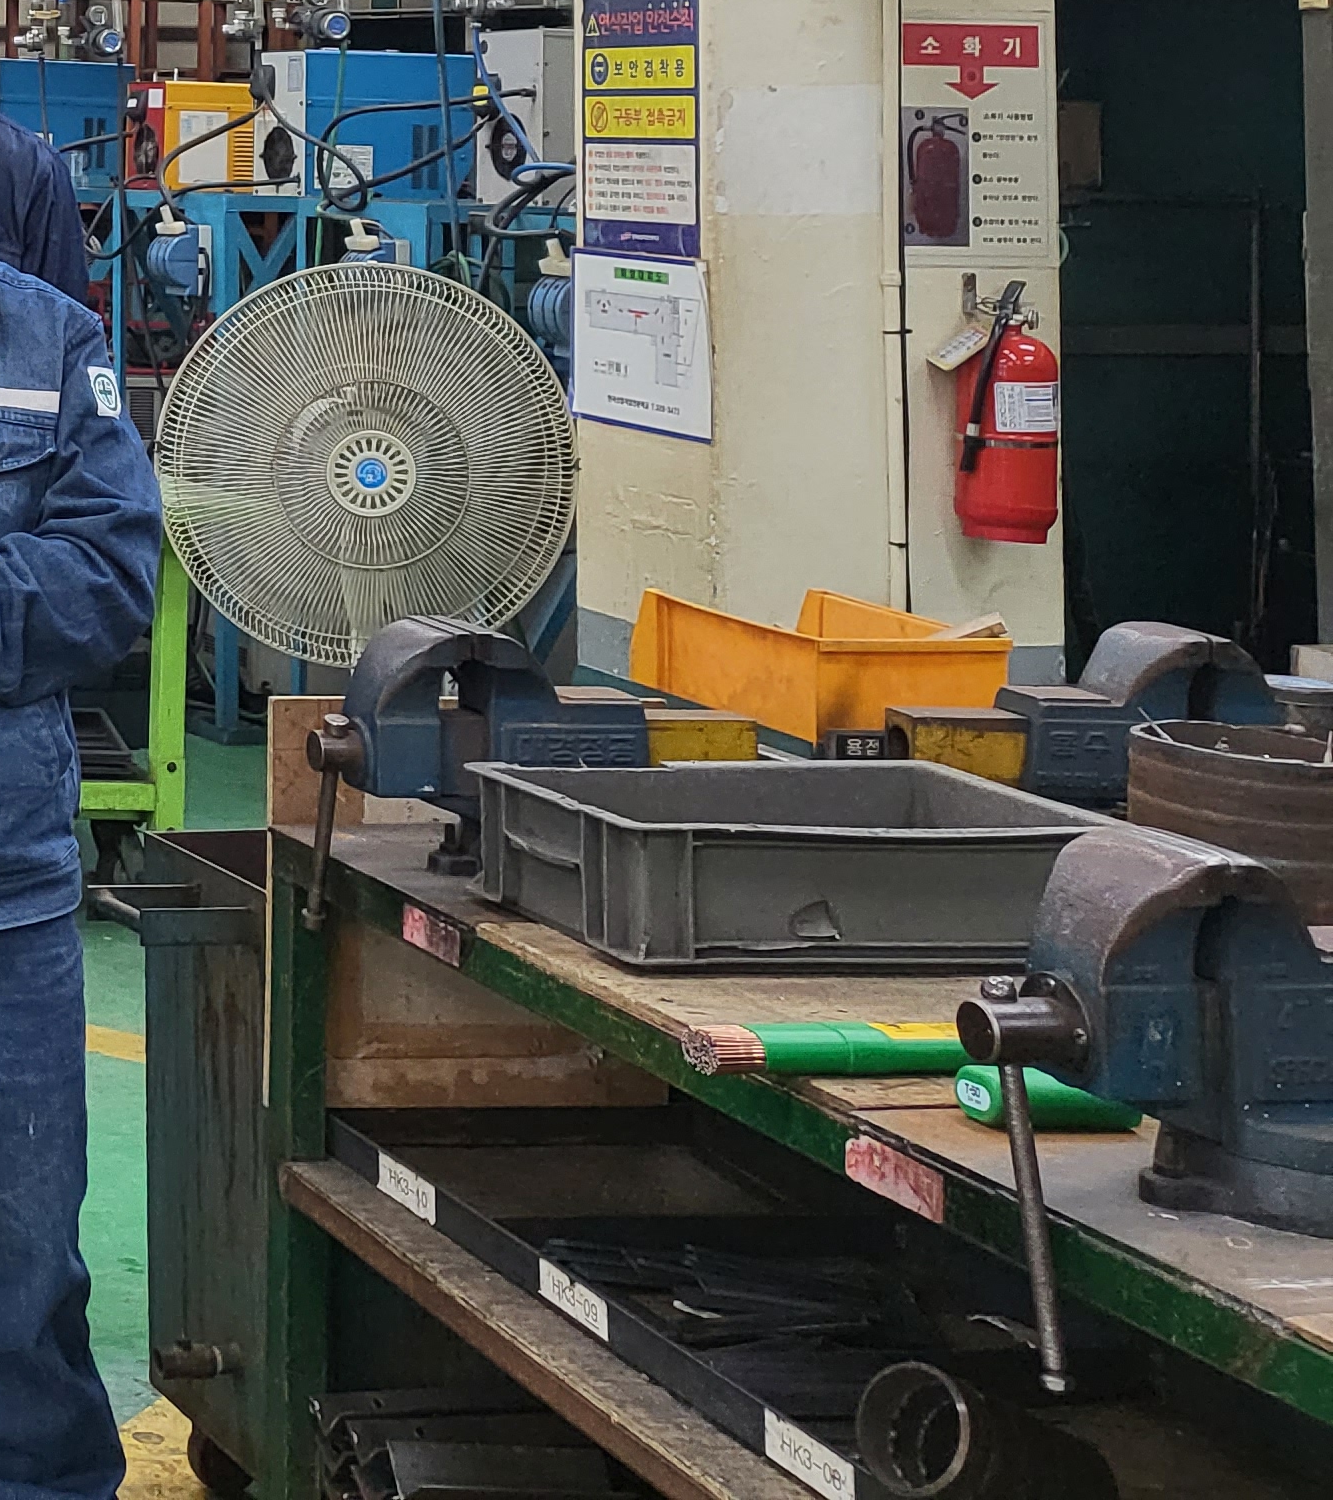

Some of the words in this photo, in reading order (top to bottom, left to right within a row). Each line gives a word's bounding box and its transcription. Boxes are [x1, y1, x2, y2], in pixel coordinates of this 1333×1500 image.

[919, 35, 1022, 58] 소화기
[613, 58, 685, 79] 보안경착용
[613, 107, 643, 127] 구동부
[551, 1276, 598, 1322] HK3-09
[780, 1432, 841, 1491] HK3-08
